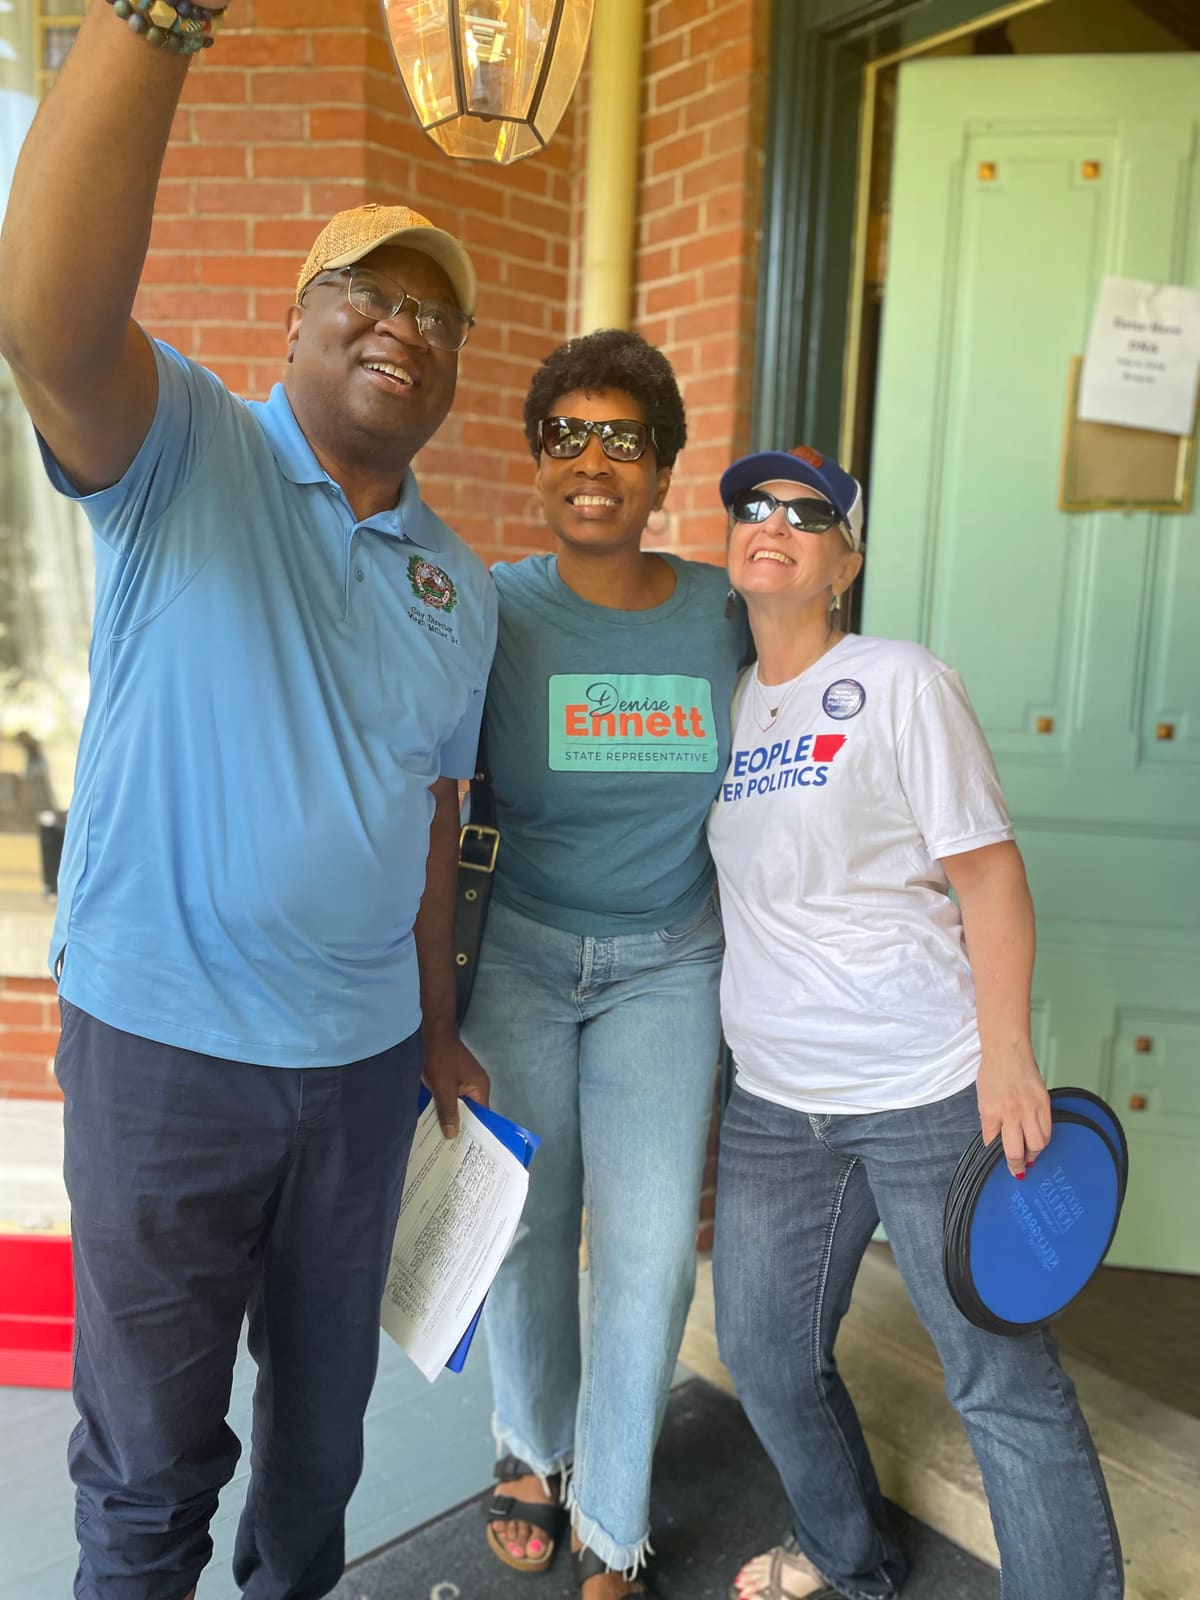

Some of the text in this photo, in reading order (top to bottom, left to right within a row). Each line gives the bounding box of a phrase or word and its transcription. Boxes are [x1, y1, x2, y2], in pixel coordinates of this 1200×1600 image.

[585, 682, 671, 718] Denise
[564, 704, 706, 739] Ennett
[565, 751, 709, 762] STATE REPRESENTATIVE
[733, 734, 814, 777] EOPLE
[722, 766, 829, 802] ER POLITICS
